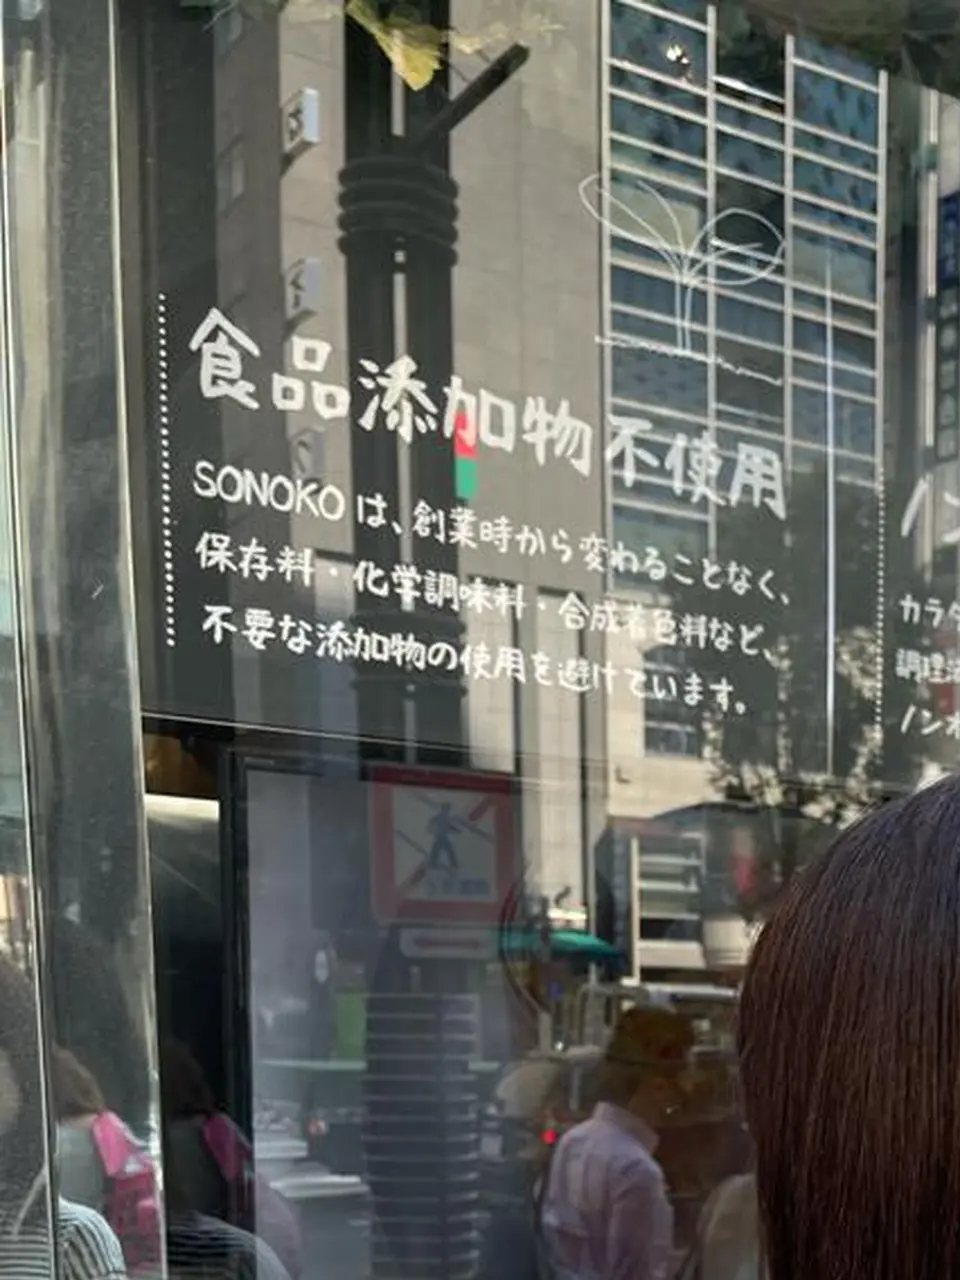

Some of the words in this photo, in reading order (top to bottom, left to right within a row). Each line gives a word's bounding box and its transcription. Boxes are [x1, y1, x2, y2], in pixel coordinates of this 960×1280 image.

[189, 306, 789, 520] 食品添加物不使用
[193, 460, 345, 521] SONOKO
